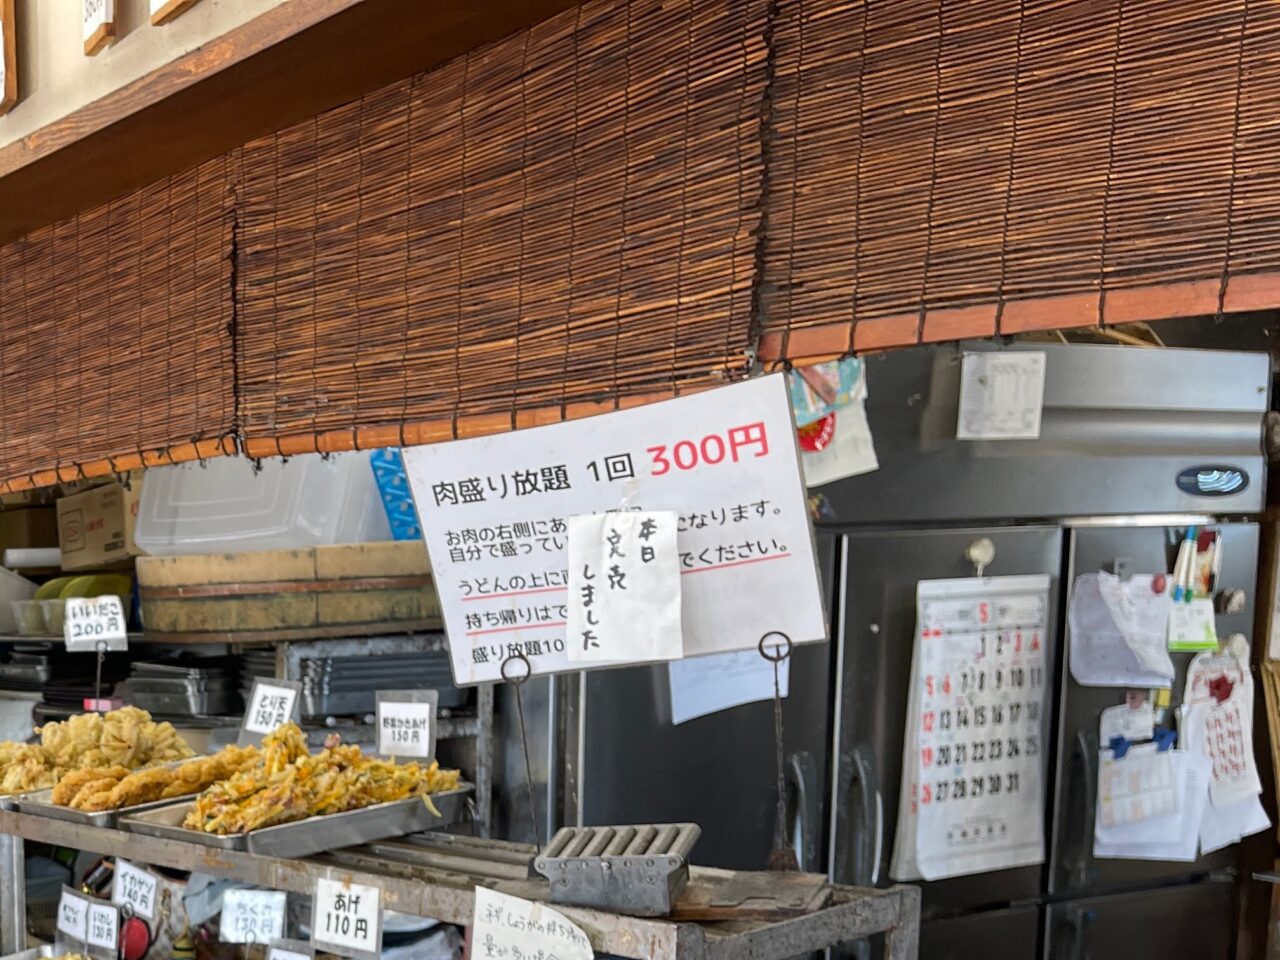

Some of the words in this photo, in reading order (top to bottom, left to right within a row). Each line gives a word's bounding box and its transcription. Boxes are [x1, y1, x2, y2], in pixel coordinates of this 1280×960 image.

[431, 464, 572, 507] 肉盛り放題
[586, 452, 635, 484] 1回
[646, 421, 770, 477] 300円
[445, 517, 567, 547] お肉の右側にあ
[638, 517, 658, 563] 本日
[606, 527, 628, 592] 完売
[678, 538, 788, 568] でください。
[70, 602, 121, 619] いいだこ
[465, 604, 568, 632] 持ち帰りはで
[580, 565, 601, 651] しました
[978, 602, 989, 624] 5
[72, 619, 121, 637] 200円
[470, 638, 565, 665] 盛り放題10
[980, 635, 986, 658] 1
[996, 634, 1003, 656] 2
[1014, 633, 1023, 654] 3
[926, 675, 935, 696] 5
[960, 672, 969, 692] 7
[978, 670, 986, 691] 8
[995, 669, 1003, 690] 9
[1011, 668, 1024, 688] 10
[1030, 667, 1041, 685] 11
[922, 711, 935, 732] 12
[939, 709, 951, 731] 13
[956, 707, 969, 729] 14
[974, 706, 986, 728] 15
[992, 704, 1004, 726] 16
[1009, 703, 1022, 724] 17
[391, 730, 421, 743] 150円
[921, 747, 933, 769] 19
[936, 746, 951, 767] 20
[954, 745, 967, 766] 21
[972, 743, 986, 764] 22
[989, 741, 1003, 762] 23
[1006, 739, 1021, 759] 24
[1025, 736, 1038, 757] 25
[935, 782, 950, 802] 27
[952, 779, 967, 800] 28
[970, 777, 985, 798] 29
[988, 775, 1002, 796] 30
[1006, 772, 1019, 793] 31
[122, 885, 150, 909] 140円
[334, 892, 362, 914] あげ
[325, 912, 368, 940] 110円
